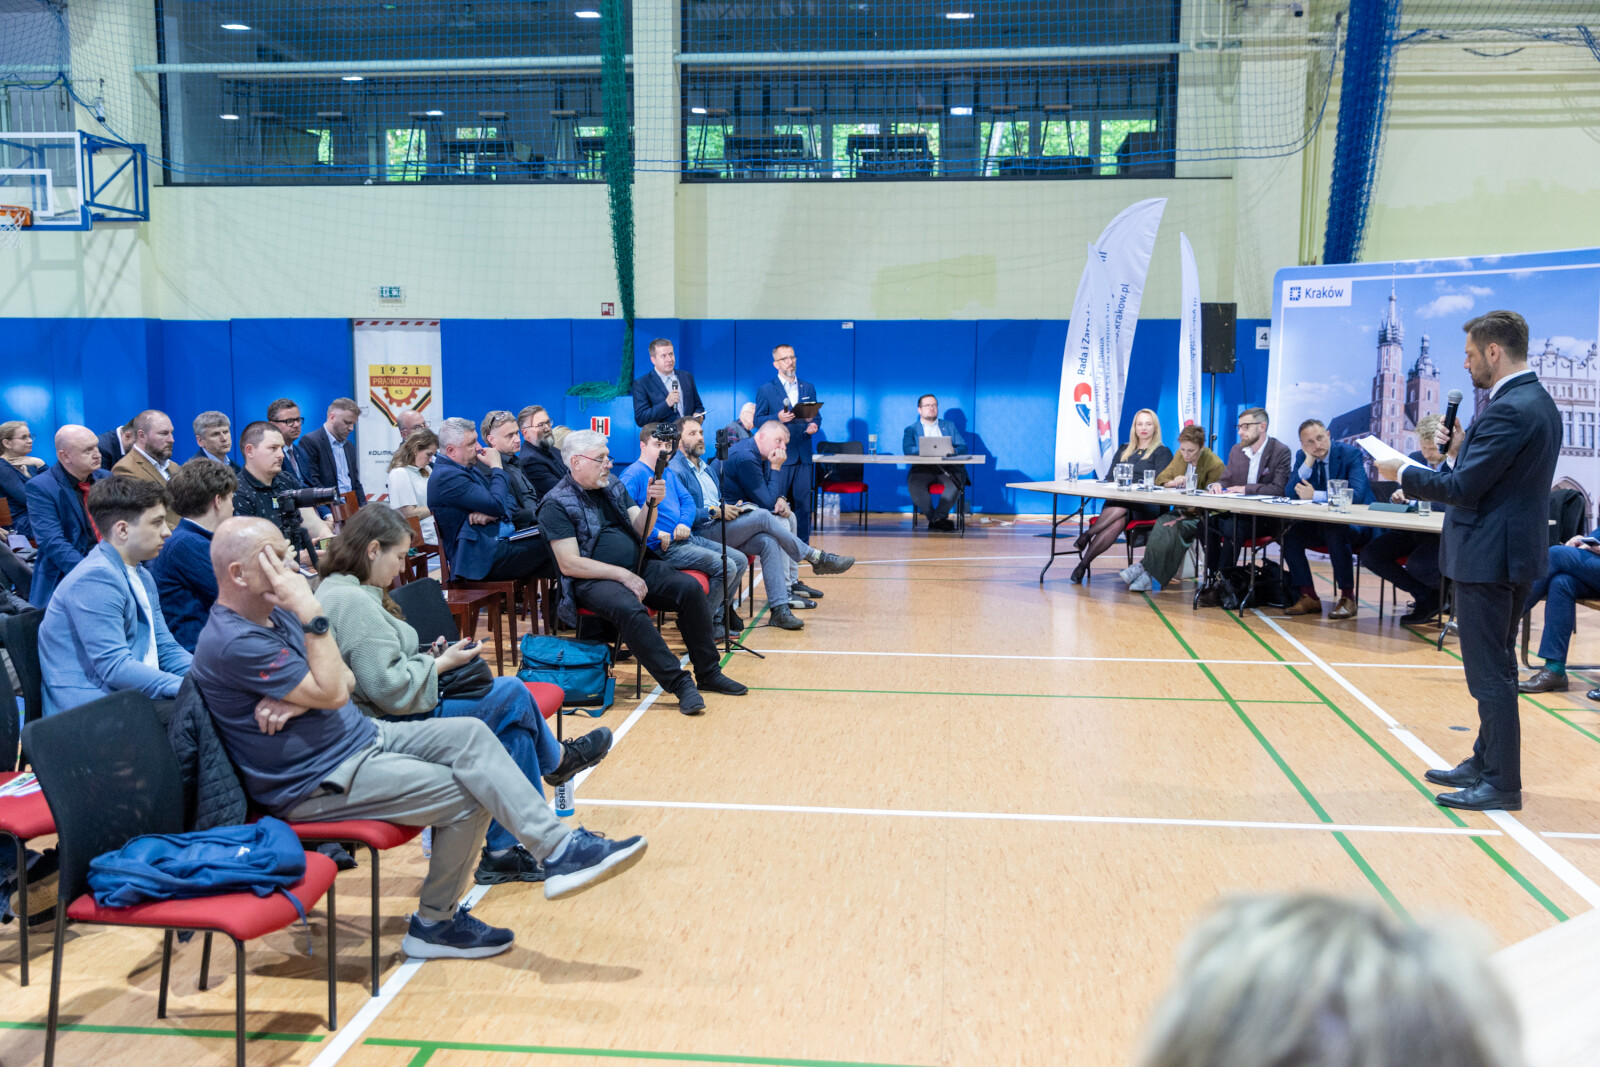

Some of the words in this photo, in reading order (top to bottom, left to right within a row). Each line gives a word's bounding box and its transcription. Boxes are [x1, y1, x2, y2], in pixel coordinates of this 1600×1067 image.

[1304, 285, 1344, 299] Kraków
[1260, 332, 1268, 342] 4
[381, 366, 419, 375] 1921
[1077, 352, 1089, 376] Rada
[596, 417, 604, 434] H
